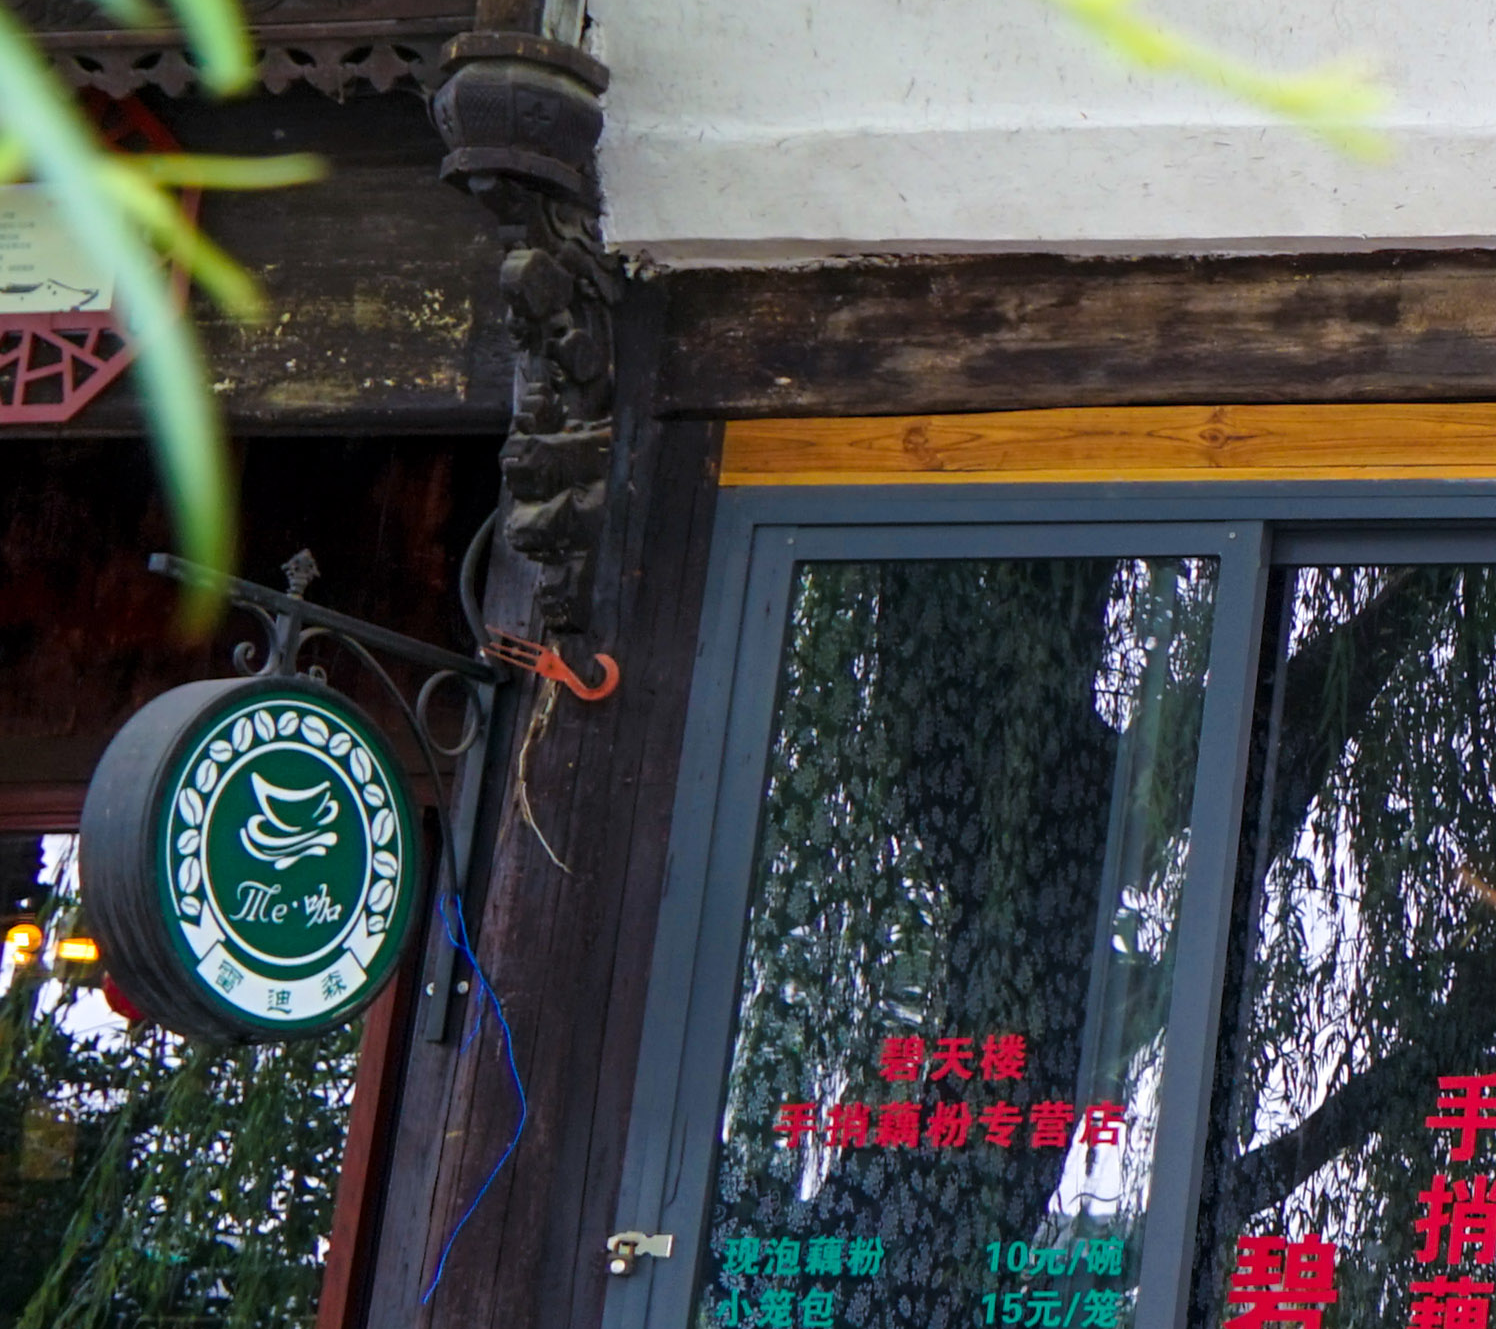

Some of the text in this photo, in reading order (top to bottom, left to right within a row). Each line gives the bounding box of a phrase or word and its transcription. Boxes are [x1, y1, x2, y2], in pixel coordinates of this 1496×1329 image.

[215, 959, 347, 1014] 雷迪森
[881, 1036, 1026, 1082] 碧天楼
[776, 1102, 1126, 1149] 手捎藕粉专营店
[723, 1235, 1126, 1278] 现泡藕粉 10元/碗
[716, 1289, 1123, 1329] 小笼包 15元/笼
